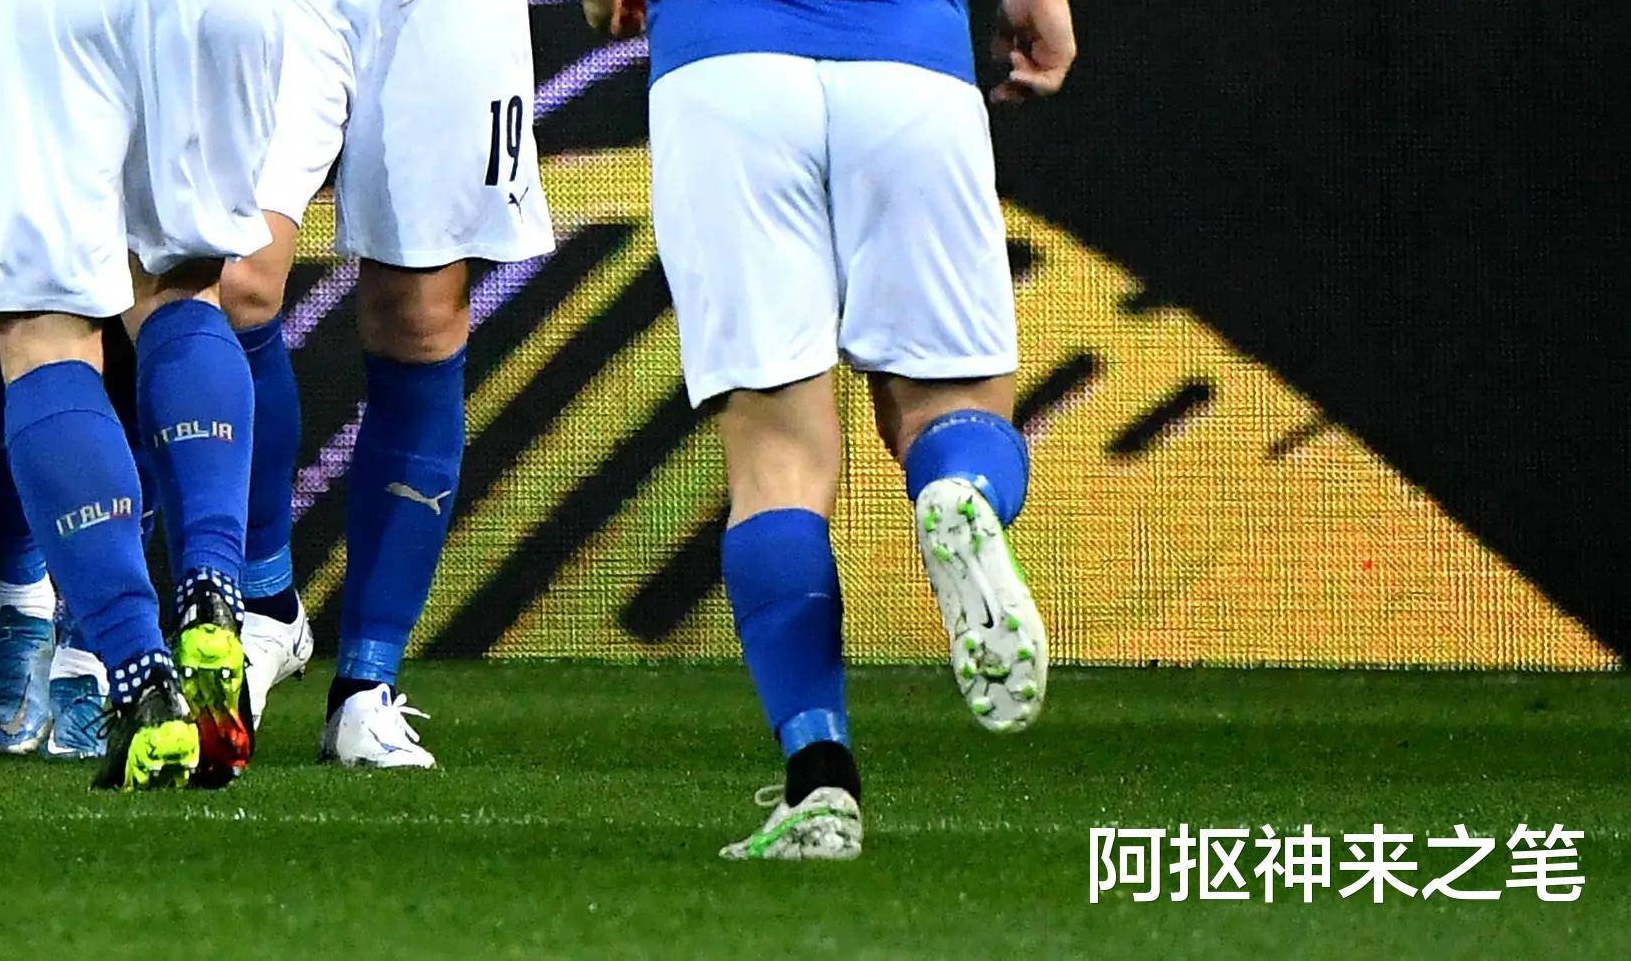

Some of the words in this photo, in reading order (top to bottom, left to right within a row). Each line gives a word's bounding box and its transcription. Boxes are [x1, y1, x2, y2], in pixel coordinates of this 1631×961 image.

[484, 94, 523, 187] 19
[154, 420, 235, 448] ITALIA
[55, 496, 133, 537] ITALIA
